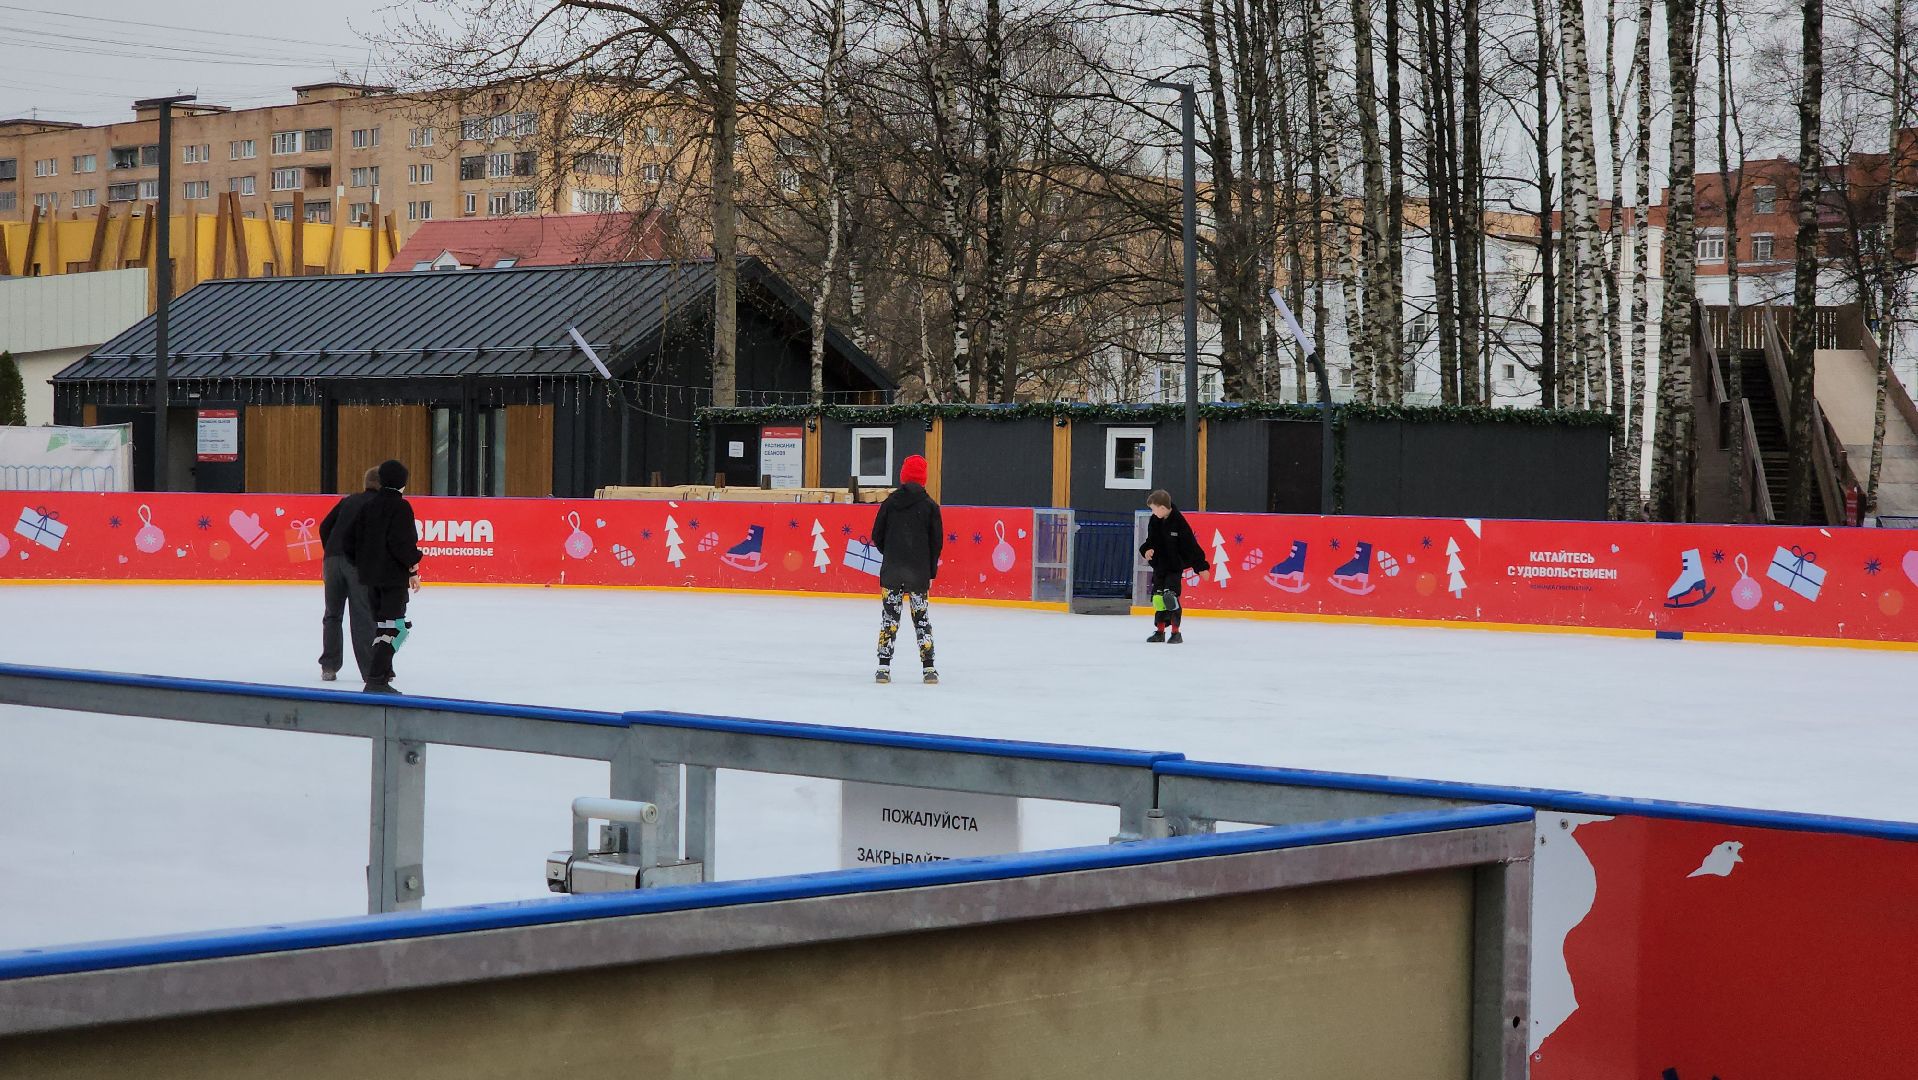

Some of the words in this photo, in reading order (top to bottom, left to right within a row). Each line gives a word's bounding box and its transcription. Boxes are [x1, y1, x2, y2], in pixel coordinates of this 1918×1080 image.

[1529, 550, 1595, 564] КАТАЙТЕСЬ
[1507, 566, 1516, 576] С
[1517, 566, 1617, 580] УДОВОЛЬСТВИЕМ!
[882, 808, 978, 832] ПОЖАЛУЙСТА
